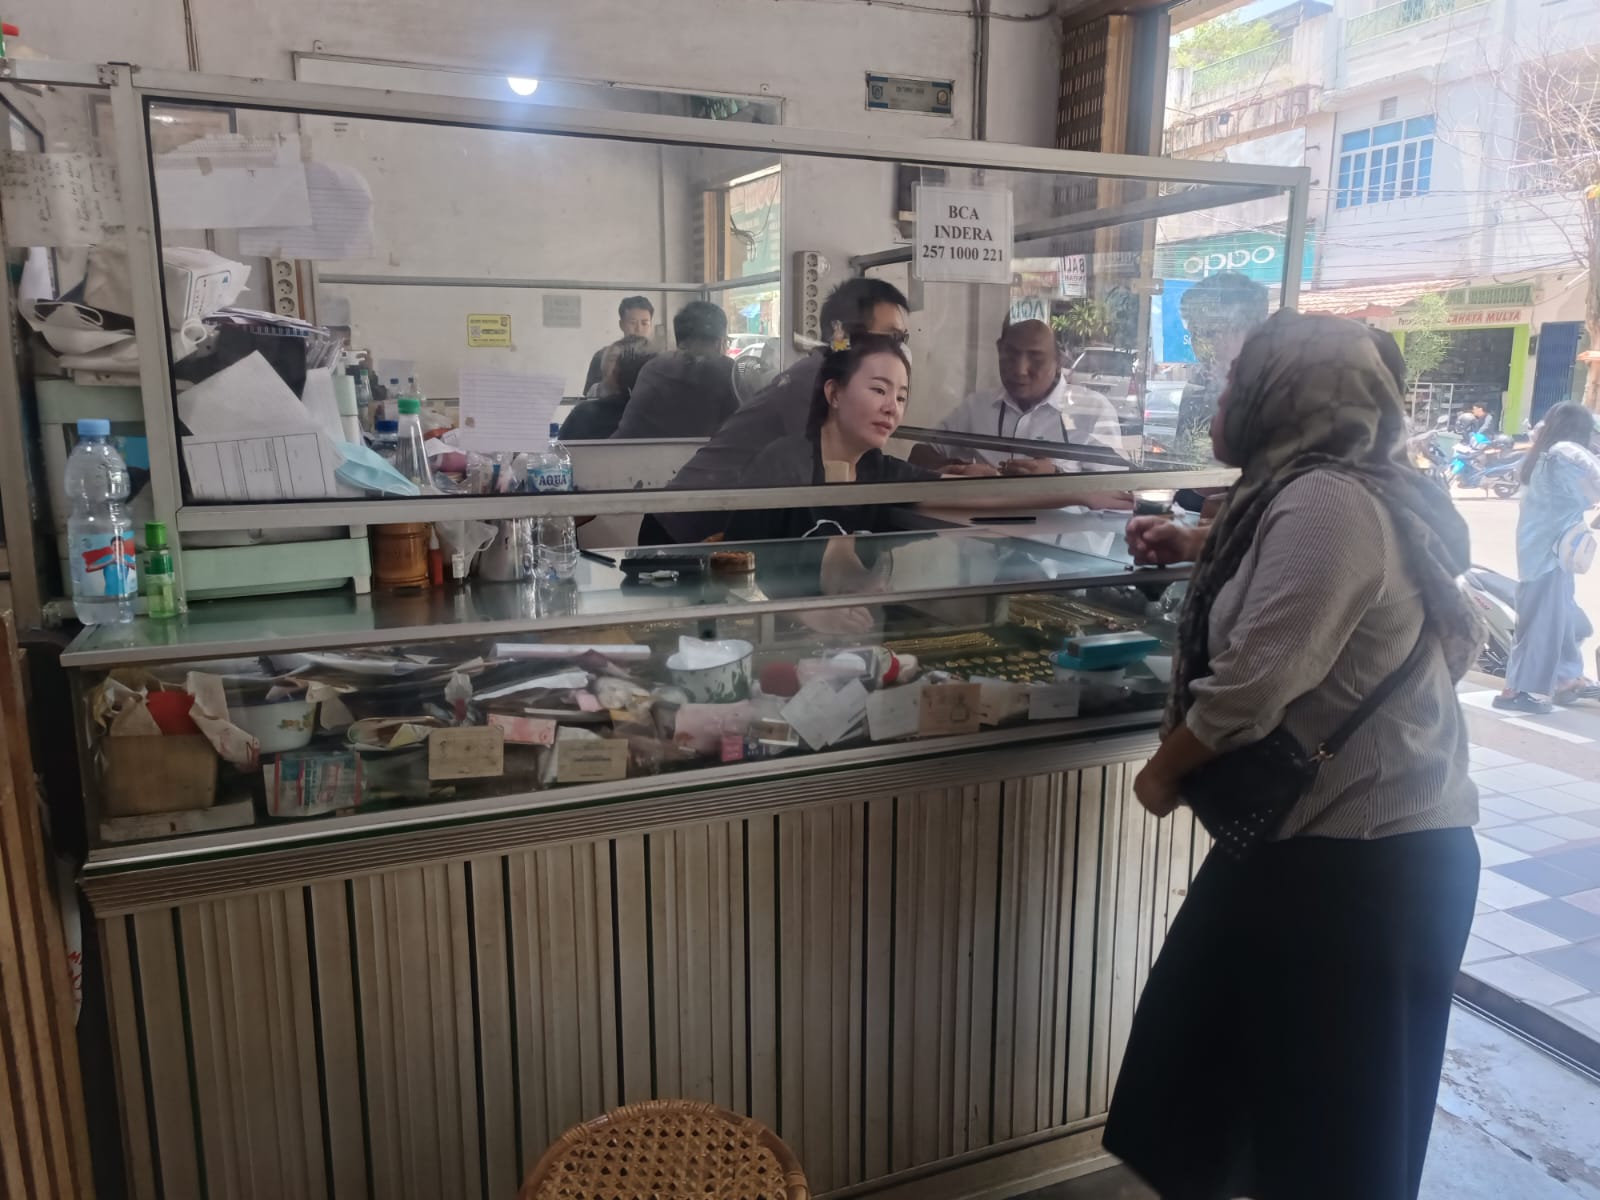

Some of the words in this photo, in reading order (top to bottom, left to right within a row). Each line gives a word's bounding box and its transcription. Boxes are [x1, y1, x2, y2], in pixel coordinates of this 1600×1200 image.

[948, 205, 980, 220] BCA
[934, 225, 993, 241] INDERA
[922, 245, 945, 259] 257
[950, 246, 979, 260] 1000
[983, 248, 1003, 262] 221
[1487, 310, 1521, 321] MULYA
[539, 474, 567, 487] AQUA
